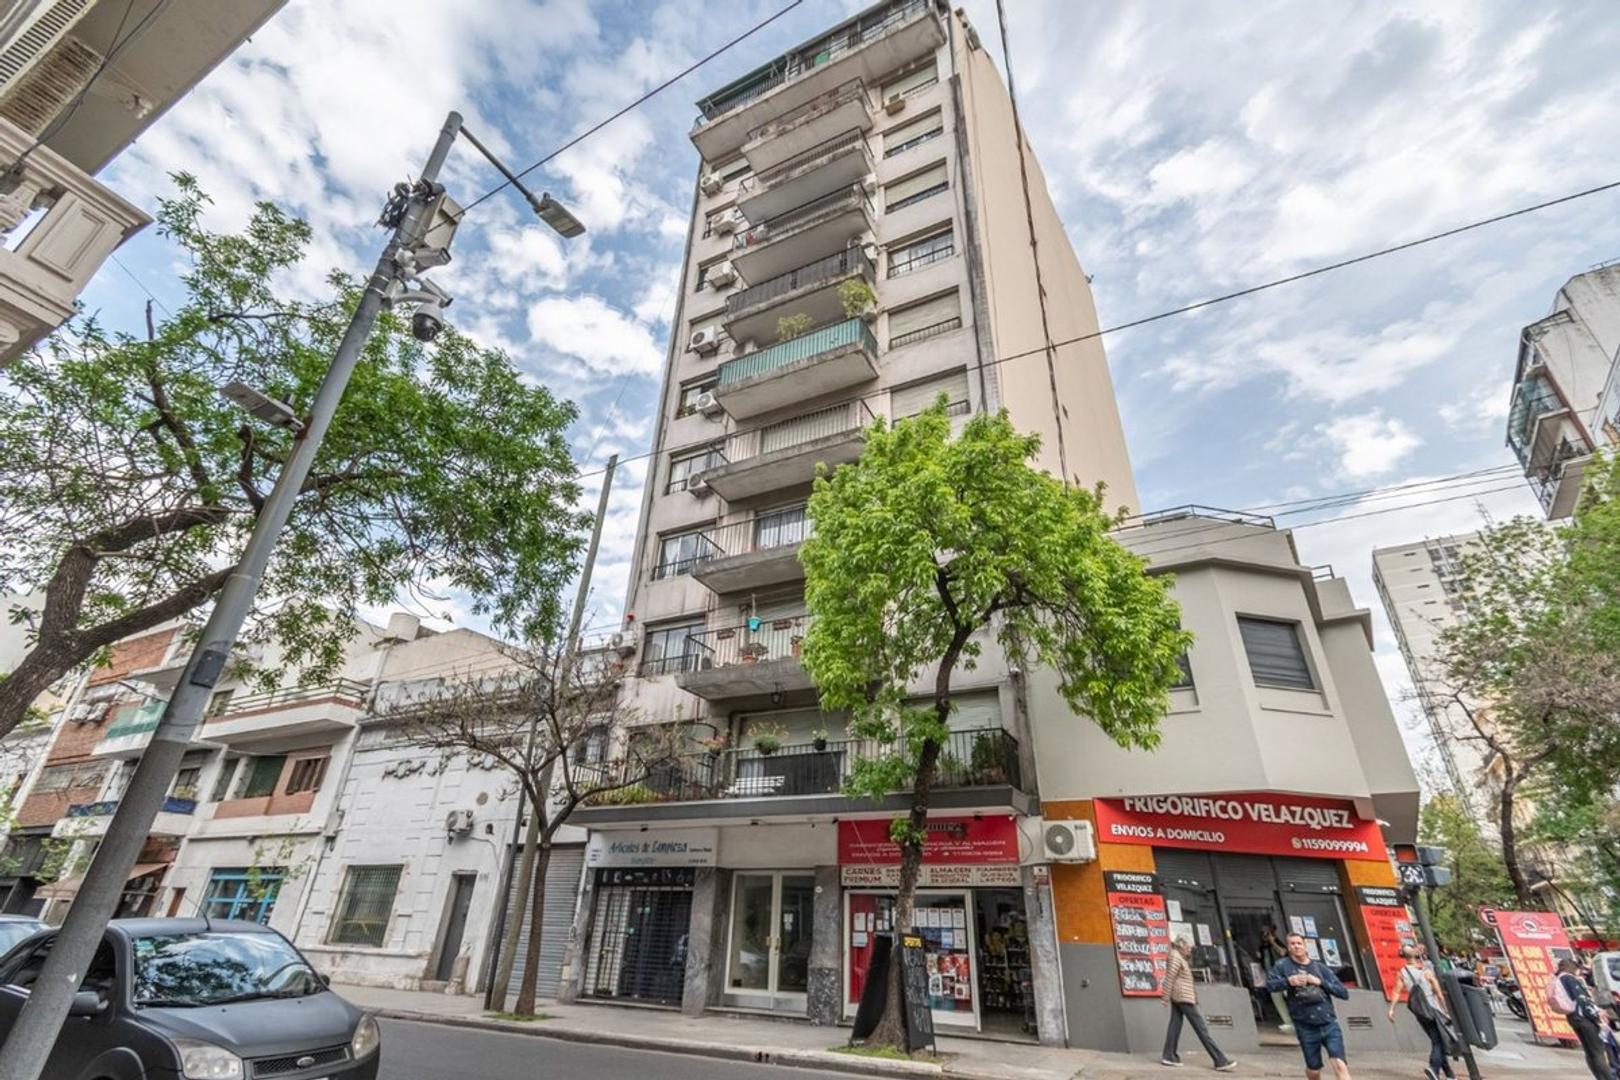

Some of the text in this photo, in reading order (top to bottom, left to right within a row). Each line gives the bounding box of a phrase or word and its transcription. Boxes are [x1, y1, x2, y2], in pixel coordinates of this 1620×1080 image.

[1123, 796, 1354, 830] FRIGORIFICO VELAZQUEZ
[1111, 824, 1225, 843] ENVIOS A DOMICILIO
[1302, 838, 1369, 852] 1159099994
[845, 867, 882, 875] CARNES
[844, 875, 882, 883] PREMIUM
[1113, 873, 1153, 882] FRIGORIFICO
[1115, 882, 1153, 892] VELAZQUEZ
[1118, 896, 1154, 906] OFERTAS
